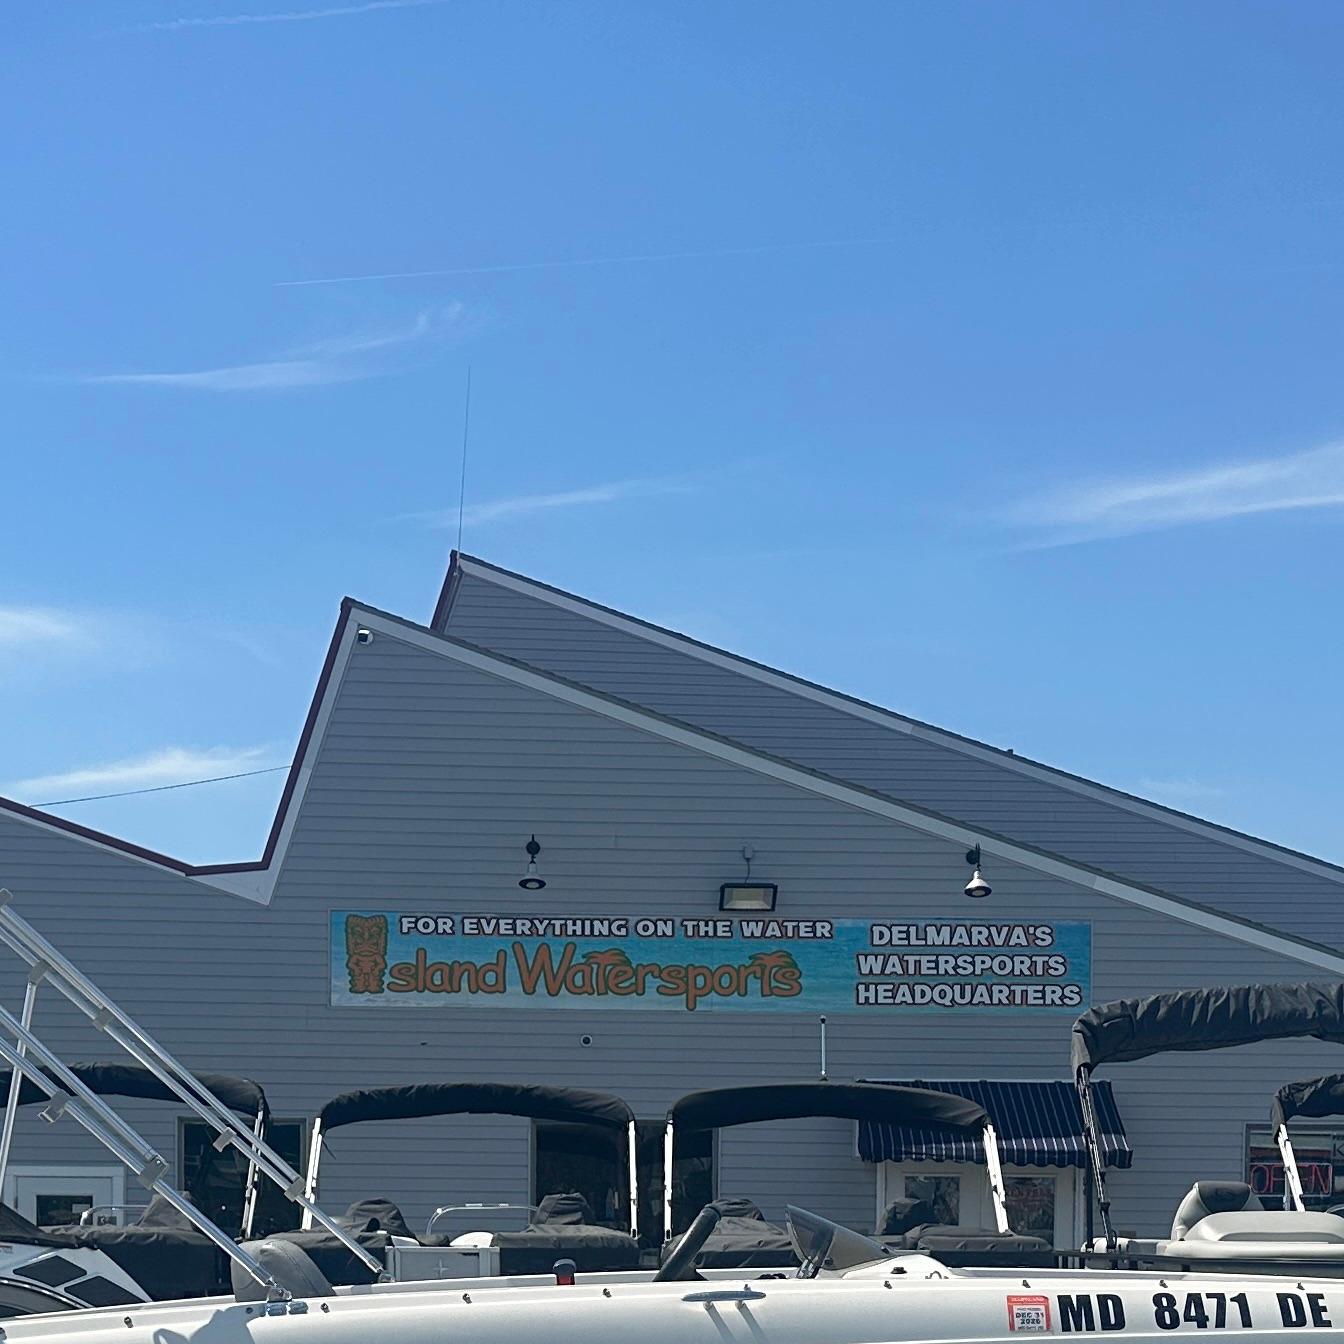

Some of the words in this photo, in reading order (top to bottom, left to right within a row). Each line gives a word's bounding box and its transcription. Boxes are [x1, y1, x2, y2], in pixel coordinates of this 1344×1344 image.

[401, 916, 455, 935] FOR
[462, 917, 627, 937] EVERYTHING
[635, 918, 674, 937] ON
[682, 919, 733, 938] THE
[740, 919, 834, 939] WATER
[871, 924, 1054, 947] DELMARVA'S
[857, 953, 1067, 976] WATERSPORTS
[857, 983, 1082, 1007] HEADQUARTERS
[1057, 1294, 1126, 1333] MD
[1153, 1292, 1253, 1330] 8471
[1276, 1292, 1333, 1329] DE
